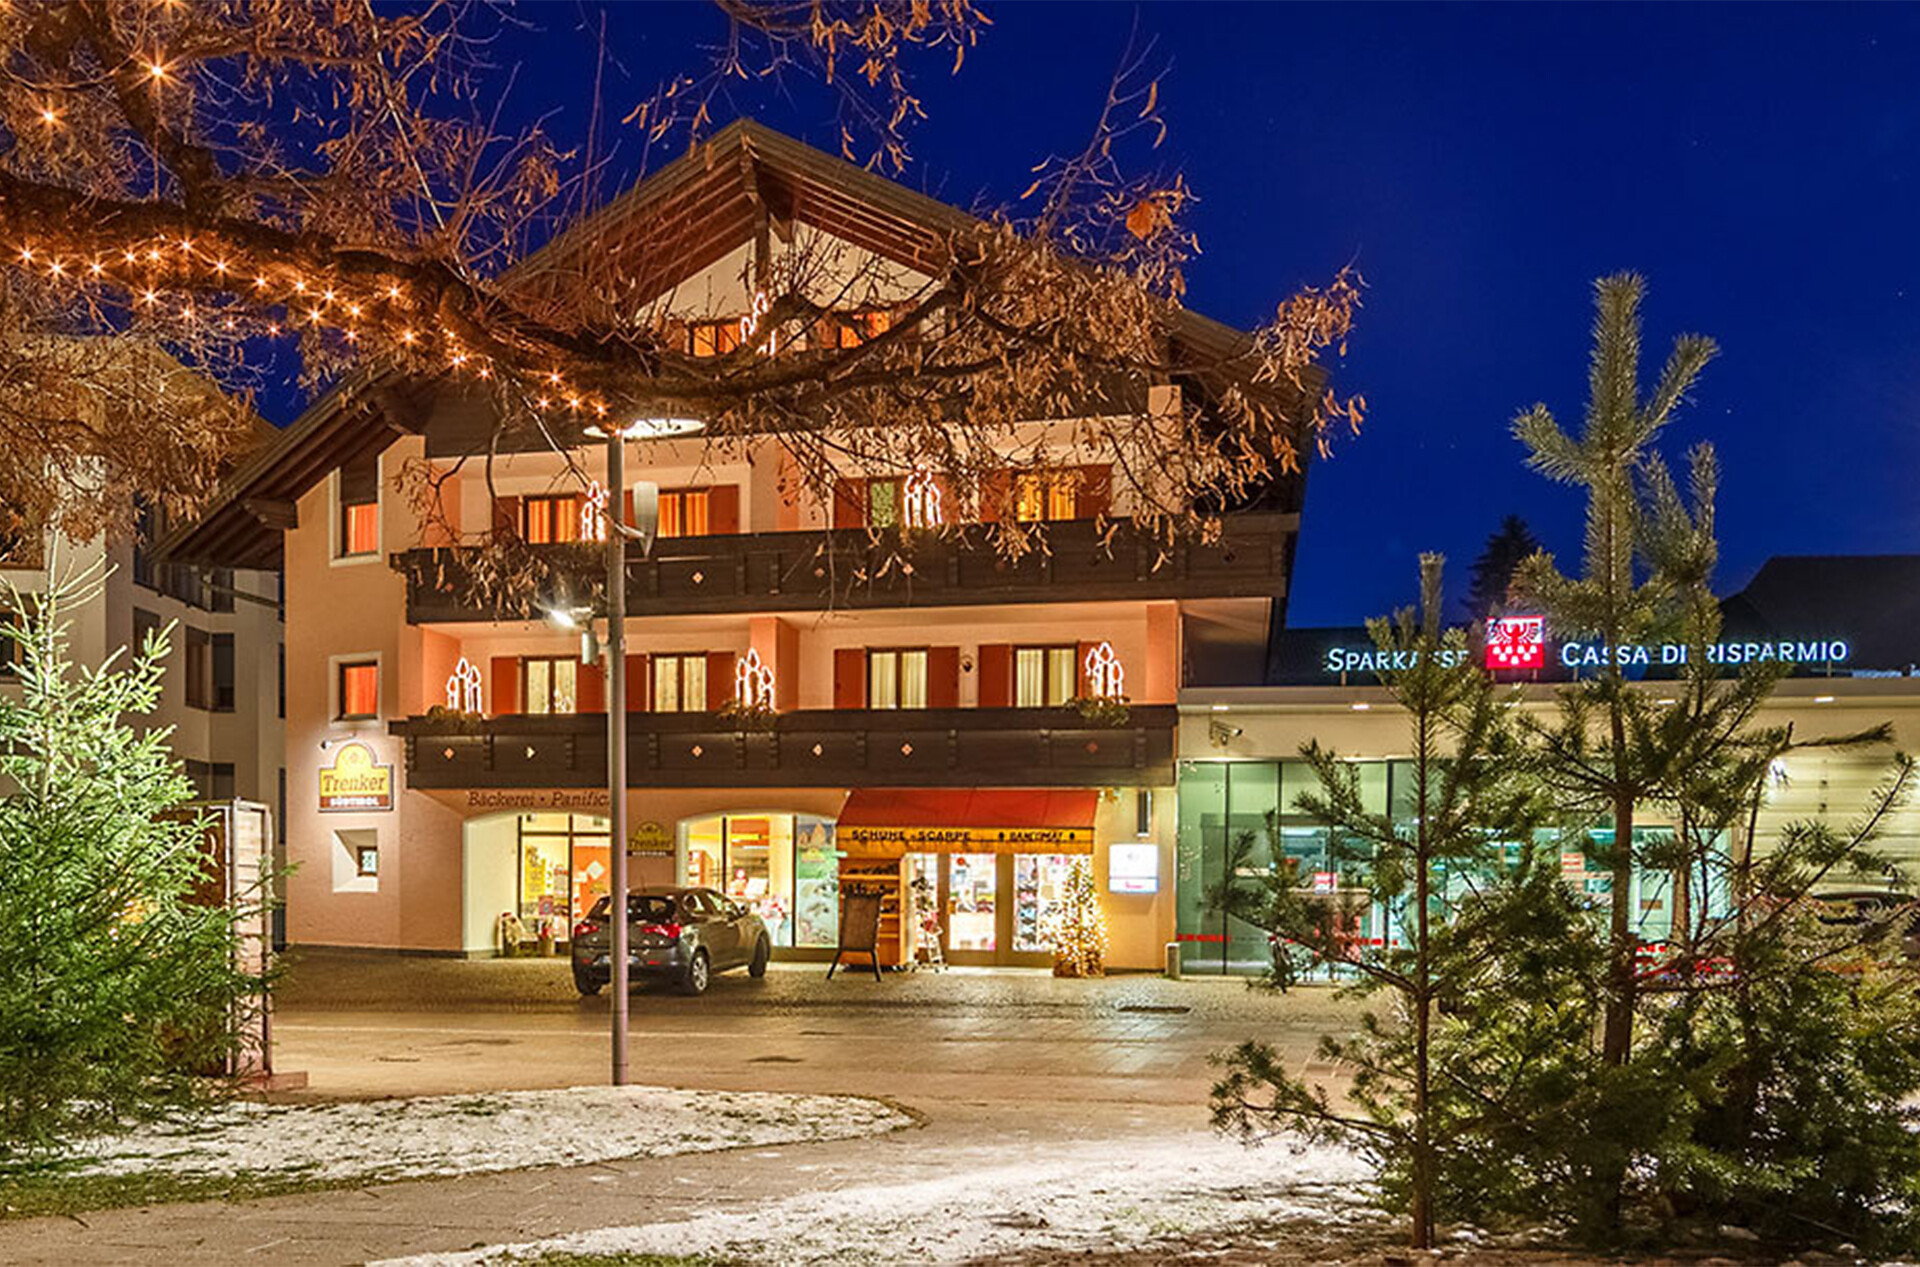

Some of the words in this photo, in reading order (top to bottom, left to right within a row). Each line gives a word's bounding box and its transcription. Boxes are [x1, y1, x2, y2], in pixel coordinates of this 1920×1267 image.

[1661, 644, 1688, 664] DI
[323, 774, 385, 792] Trenker
[468, 790, 534, 807] Bäckerei
[550, 790, 610, 806] Panific
[852, 829, 905, 841] SCHUHE
[918, 830, 971, 843] SCARPE
